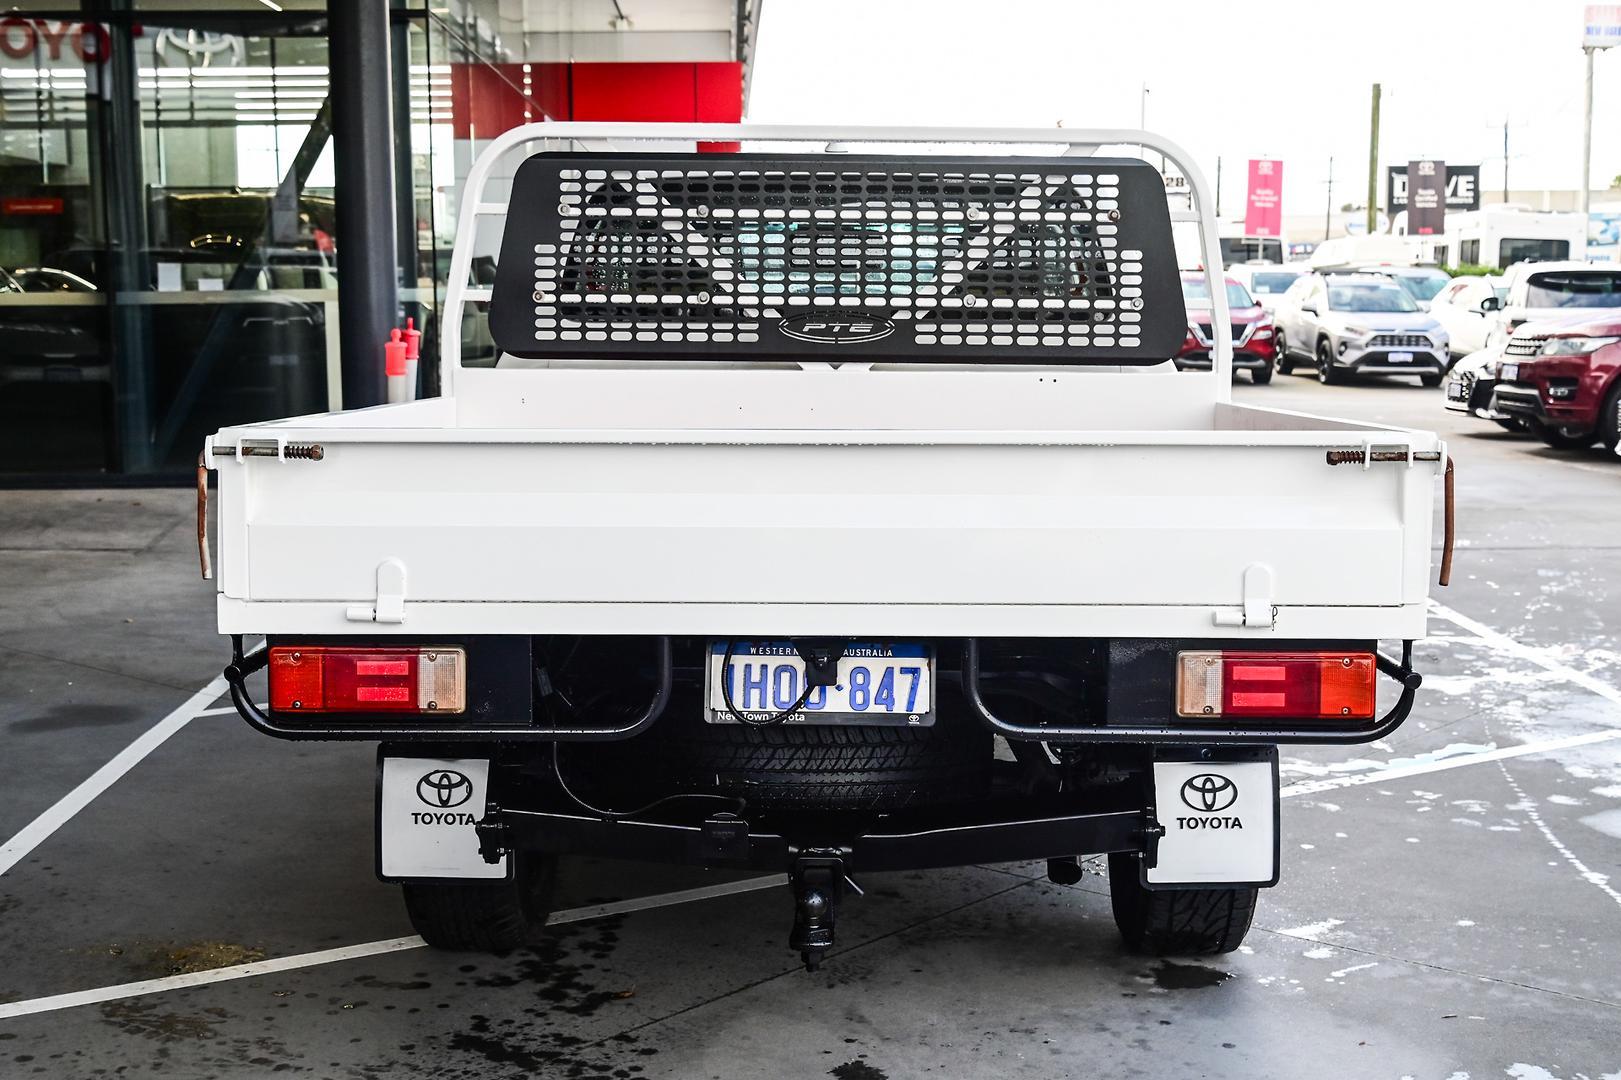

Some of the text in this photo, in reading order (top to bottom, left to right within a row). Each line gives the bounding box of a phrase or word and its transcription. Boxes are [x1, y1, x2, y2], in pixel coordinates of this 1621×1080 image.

[1392, 173, 1475, 198] DVE
[802, 322, 874, 333] PTE
[842, 648, 893, 658] AUSTRALIA
[741, 711, 769, 721] Town
[770, 711, 806, 724] Tota
[411, 812, 477, 826] TOYOTA
[1176, 816, 1243, 830] TOYOTA
